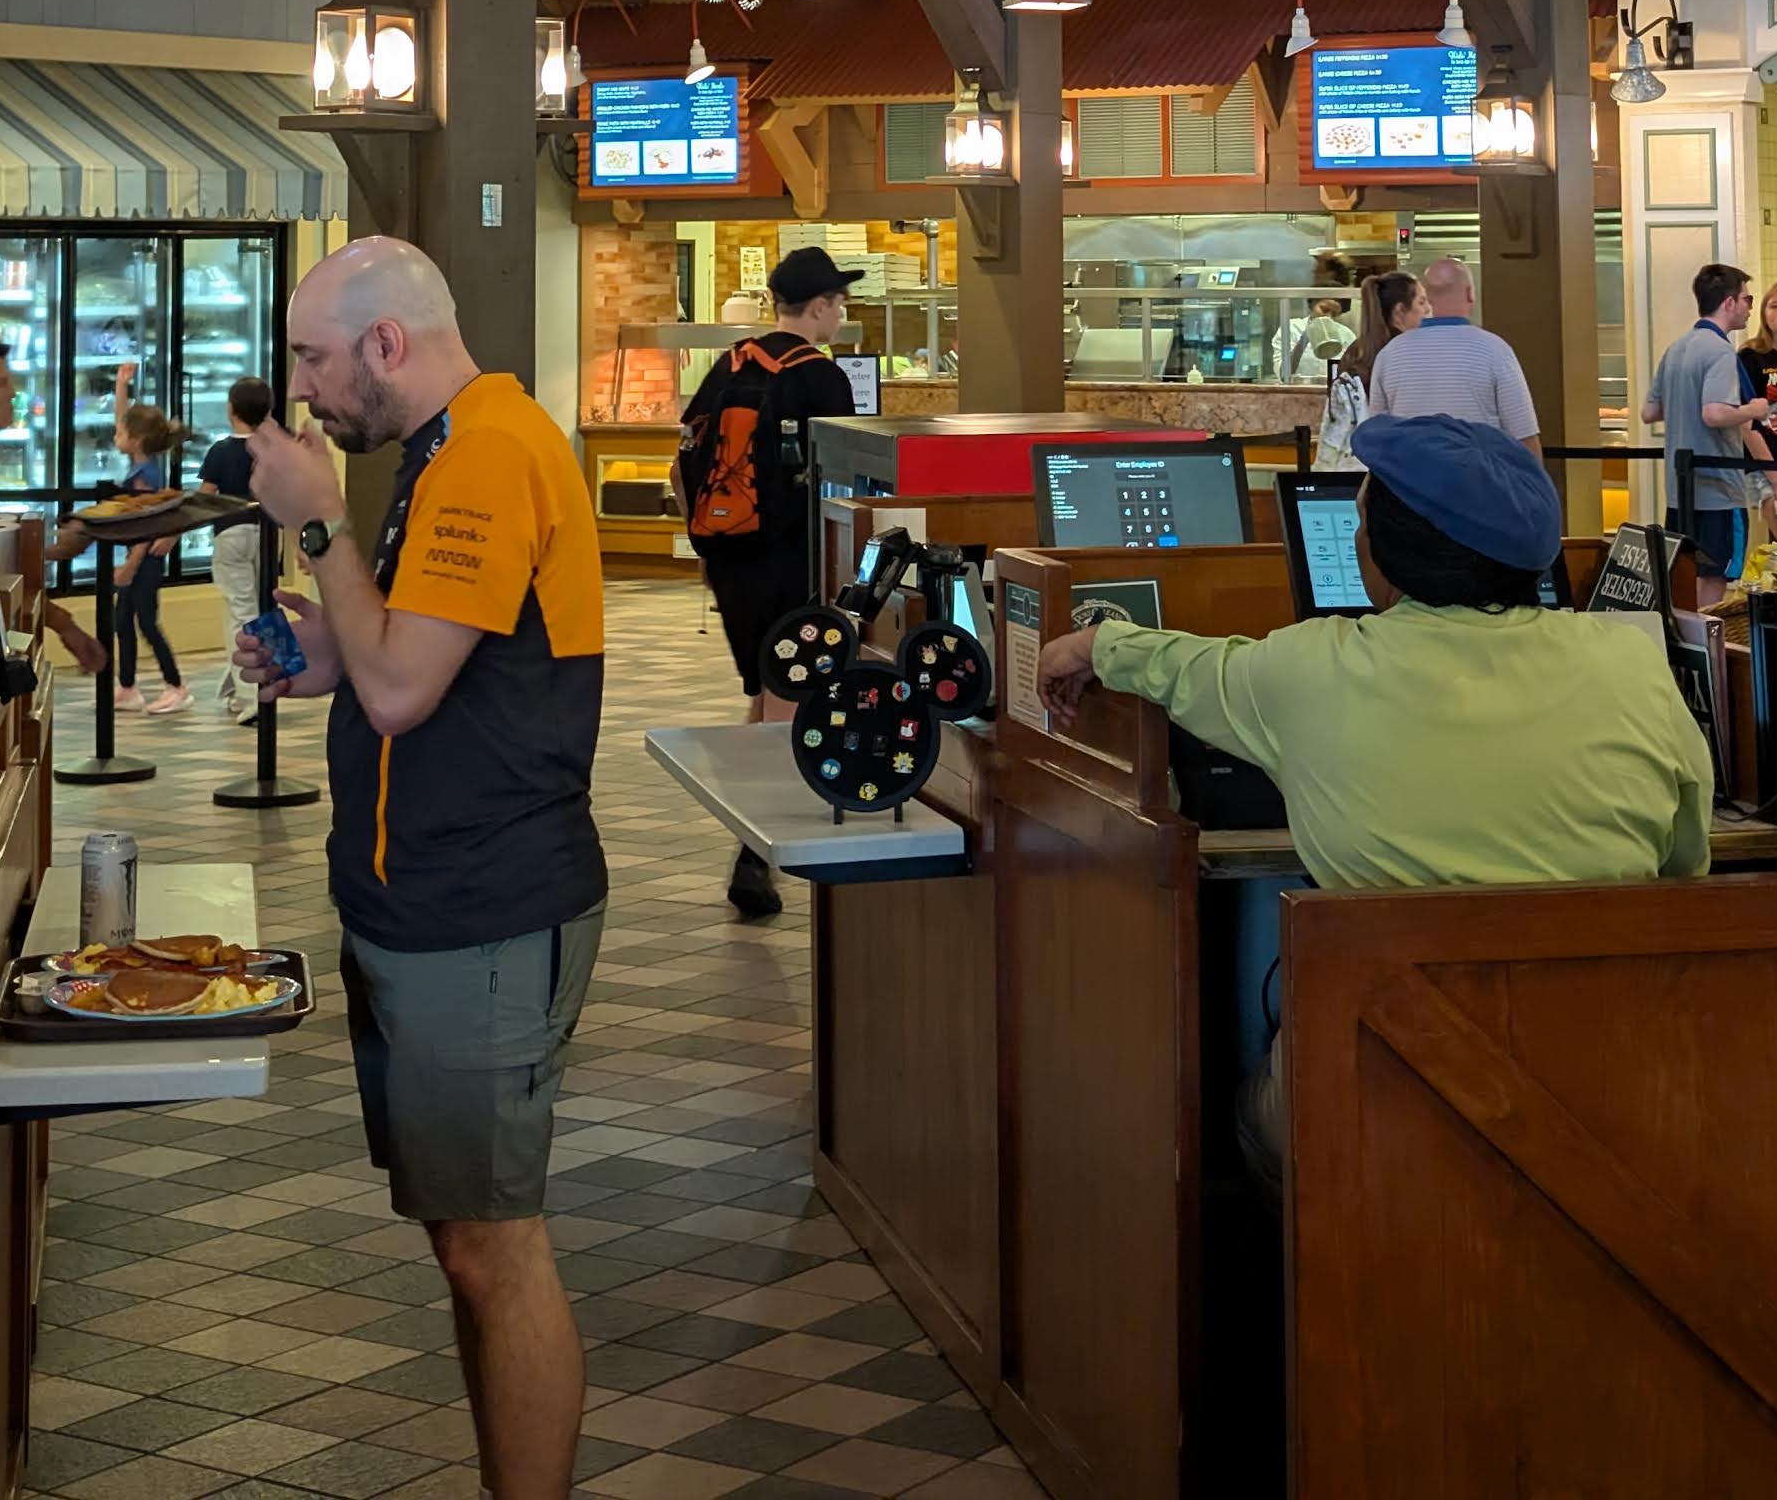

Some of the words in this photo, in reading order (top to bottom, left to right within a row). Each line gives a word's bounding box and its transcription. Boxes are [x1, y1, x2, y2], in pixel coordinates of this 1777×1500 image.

[849, 372, 871, 381] nter
[1115, 461, 1130, 469] Enter
[1131, 461, 1157, 470] Employee
[1157, 460, 1165, 468] ID
[1122, 491, 1129, 500] 1
[1140, 491, 1148, 499] 2
[1159, 490, 1166, 499] 3
[1124, 508, 1132, 516] 4
[1143, 508, 1150, 516] 5
[1161, 507, 1168, 516] 6
[1126, 525, 1133, 534] 7
[1145, 525, 1152, 533] 8
[1163, 524, 1170, 533] 9
[1600, 572, 1654, 608] REGISTER
